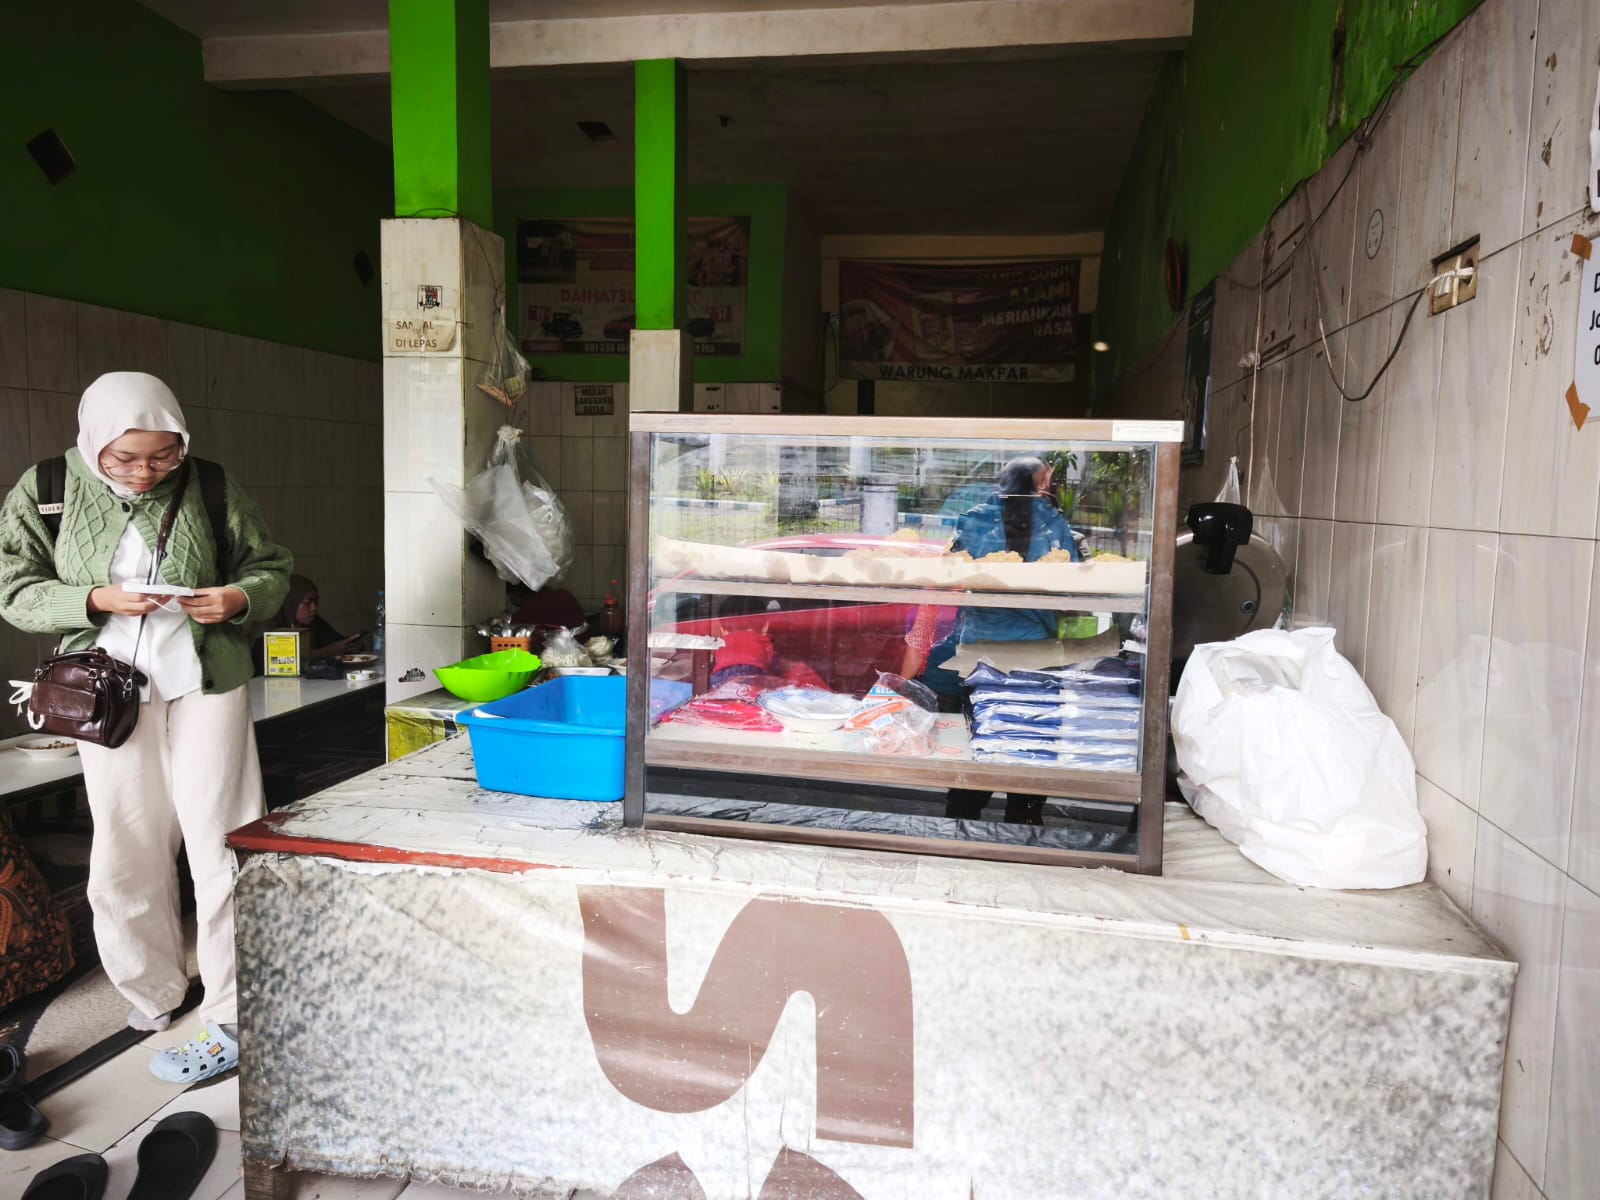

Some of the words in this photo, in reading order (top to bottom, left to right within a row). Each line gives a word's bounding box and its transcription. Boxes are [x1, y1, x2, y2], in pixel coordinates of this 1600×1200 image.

[981, 303, 1073, 326] MERIAHKAN
[1033, 320, 1073, 337] RASA
[395, 339, 405, 348] DI
[409, 339, 437, 348] LEPAS
[879, 363, 953, 380] WARUNG
[957, 365, 1029, 381] MAKPAR
